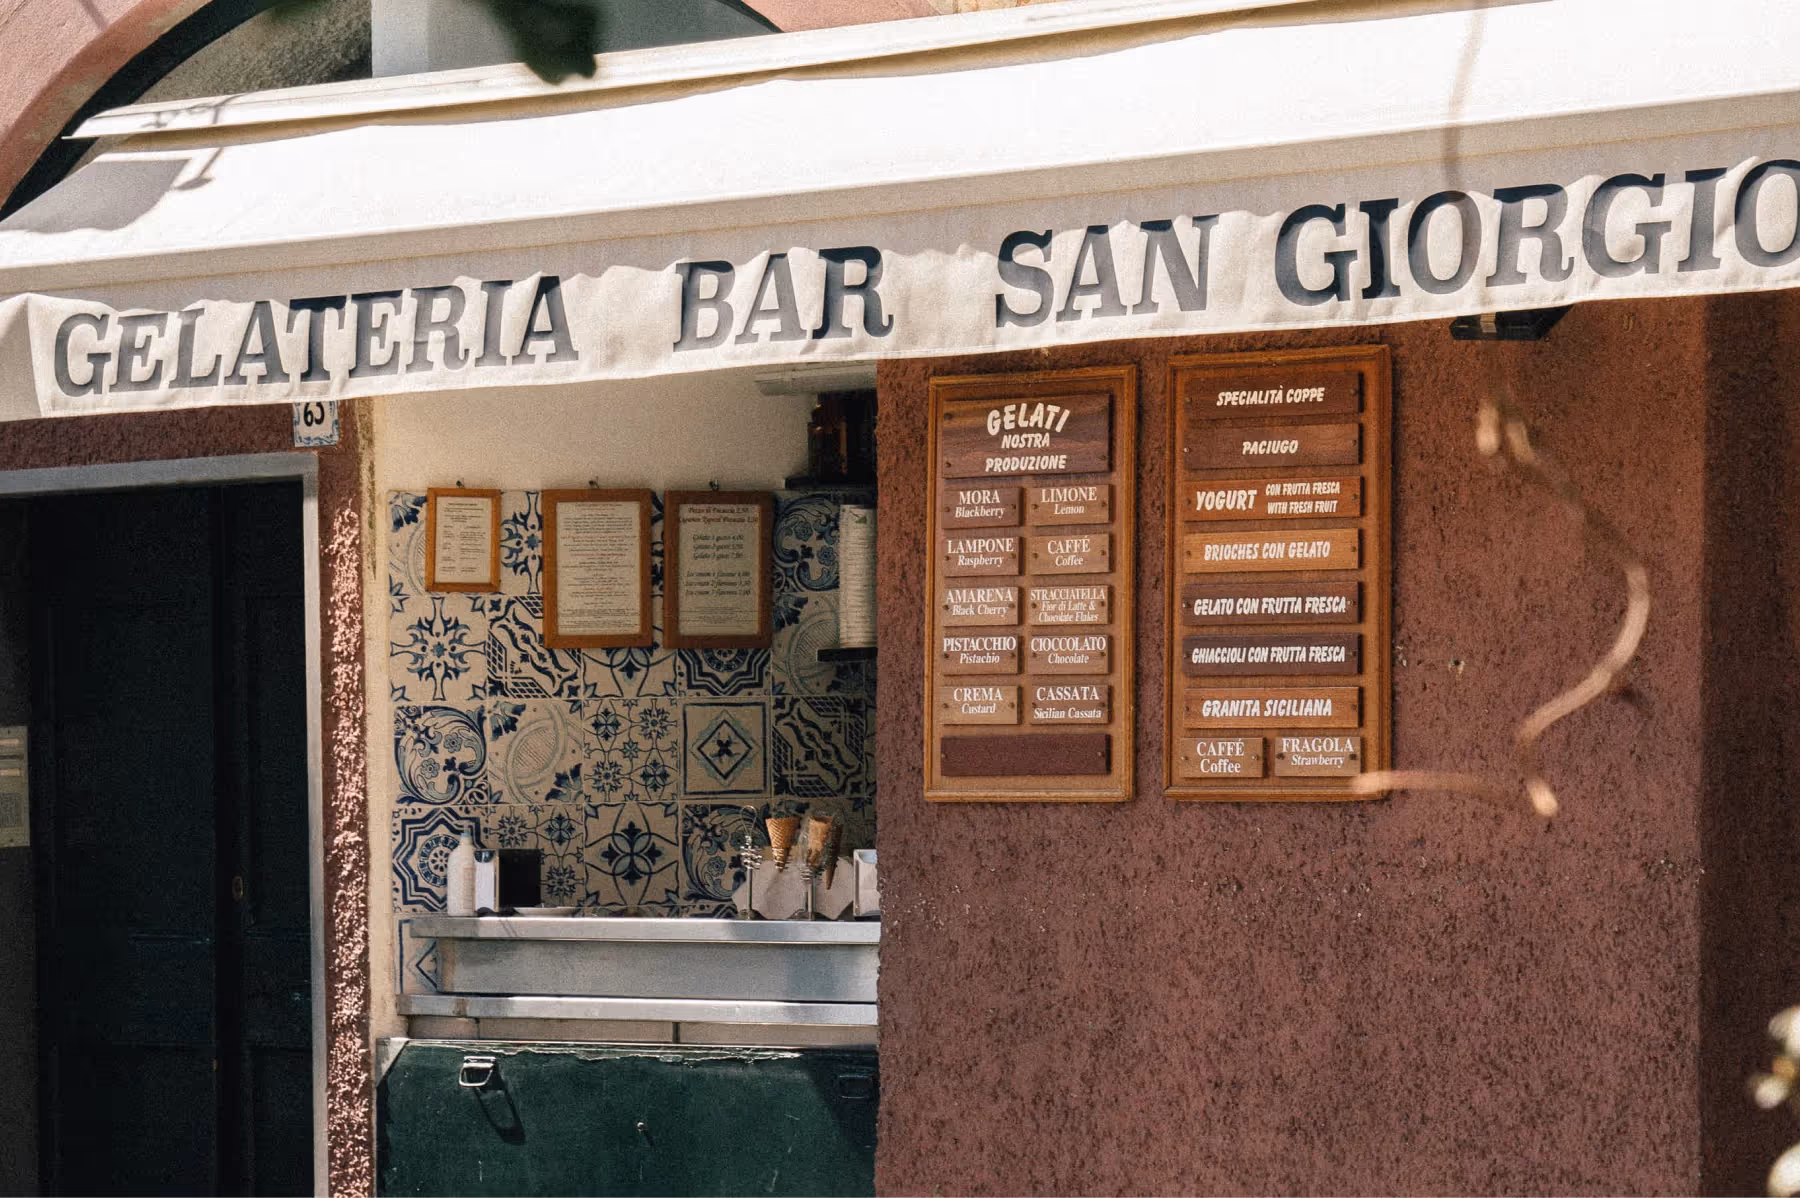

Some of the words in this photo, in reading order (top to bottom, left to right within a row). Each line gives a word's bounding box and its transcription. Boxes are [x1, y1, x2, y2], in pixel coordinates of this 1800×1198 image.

[53, 275, 579, 397] GELATERIA
[673, 246, 894, 353] BAR
[995, 214, 1219, 328] SAN
[1274, 159, 1800, 306] GIORGIO
[1216, 384, 1284, 406] SPECIALITÀ
[1286, 387, 1325, 403] COPPE
[987, 402, 1071, 436] GELATI
[1001, 433, 1050, 449] NOSTRA
[1242, 440, 1298, 455] PACIUGO
[985, 454, 1068, 472] PRODUZIONE
[1041, 486, 1097, 502] LIMONE
[1265, 484, 1281, 496] CON
[1282, 482, 1310, 496] FRUTTA
[1312, 481, 1340, 494] FRESCA
[959, 490, 1001, 505] MORA
[1196, 489, 1257, 511] YOGURT
[955, 506, 1005, 519] Blackberry
[1054, 503, 1085, 515] Lemon
[1267, 501, 1287, 514] WITH
[1289, 501, 1313, 513] FRESH
[1314, 500, 1338, 513] FRUIT
[947, 538, 1014, 554] LAMPONE
[1204, 543, 1259, 561] BRIOCHES
[1262, 542, 1285, 559] CON
[1288, 541, 1330, 558] GELATO
[958, 555, 1004, 567] Raspberry
[1055, 556, 1083, 567] Coffee
[946, 588, 1013, 603] AMARENA
[1030, 588, 1105, 601] STRACCIATELLA
[952, 604, 975, 616] Black
[977, 604, 1009, 617] Cherry
[1041, 601, 1058, 612] Fior
[1059, 601, 1066, 611] di
[1089, 601, 1096, 611] &
[1194, 598, 1234, 615] GELATO
[1236, 598, 1258, 615] CON
[1261, 597, 1302, 615] FRUTTA
[1305, 596, 1346, 614] FRESCA
[1038, 612, 1073, 623] Chocolate
[1075, 611, 1099, 622] Flakes
[943, 636, 1016, 652] PISTACCHIO
[1031, 636, 1106, 652] CIOCCOLATO
[959, 652, 1000, 664] Pistachio
[1048, 652, 1090, 664] Chocolate
[1192, 647, 1246, 663] GHIACCIOLI
[1248, 647, 1268, 662] CON
[1270, 646, 1306, 663] FRUTTA
[1309, 646, 1345, 663] FRESCA
[953, 687, 1004, 702] CREMA
[1036, 686, 1099, 700] CASSATA
[961, 702, 996, 714] Custard
[1034, 708, 1066, 719] Sicilian
[1068, 707, 1102, 719] Cassata
[1202, 699, 1260, 717] GRANITA
[1264, 698, 1332, 717] SICILIANA
[1282, 737, 1353, 753] FRAGOLA
[1200, 759, 1241, 773] Coffee
[1291, 754, 1345, 768] Strawberry
